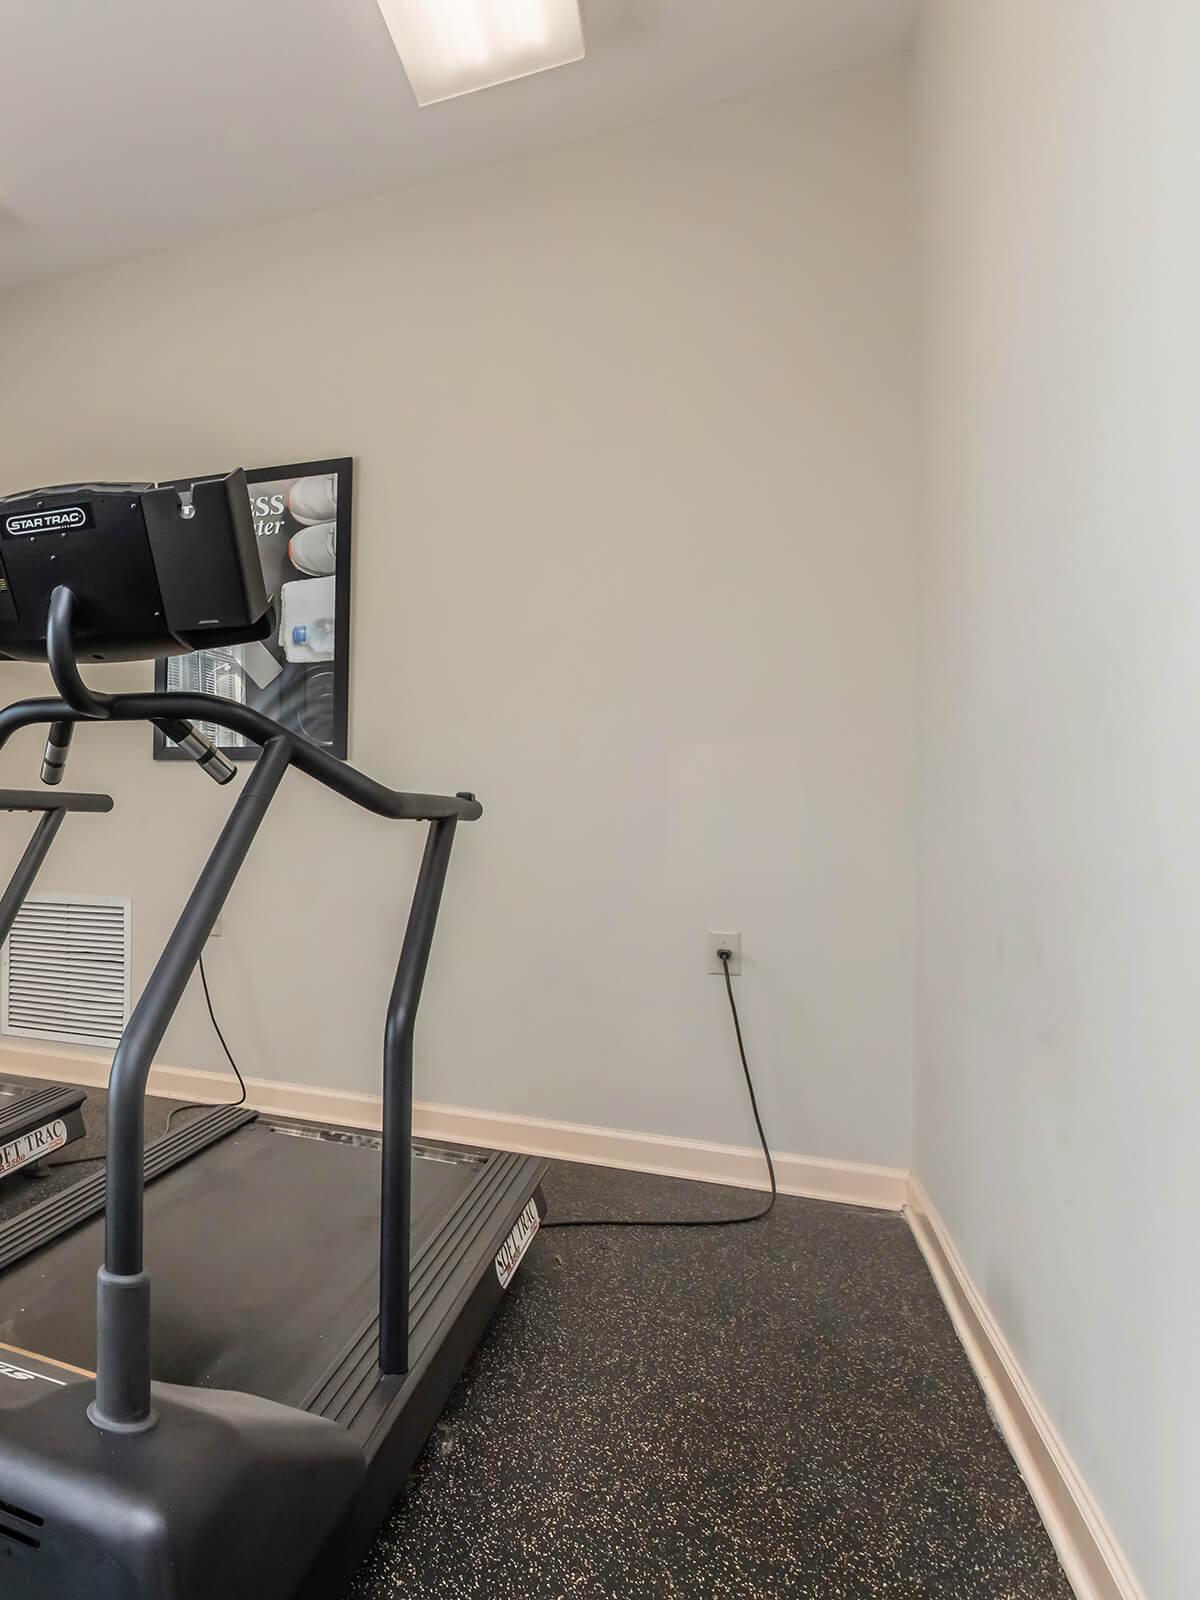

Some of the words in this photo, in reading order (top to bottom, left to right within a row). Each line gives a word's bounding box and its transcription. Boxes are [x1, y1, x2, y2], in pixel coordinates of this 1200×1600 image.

[10, 518, 43, 530] STAR
[44, 512, 79, 526] TRAC
[20, 1120, 63, 1153] TRAC
